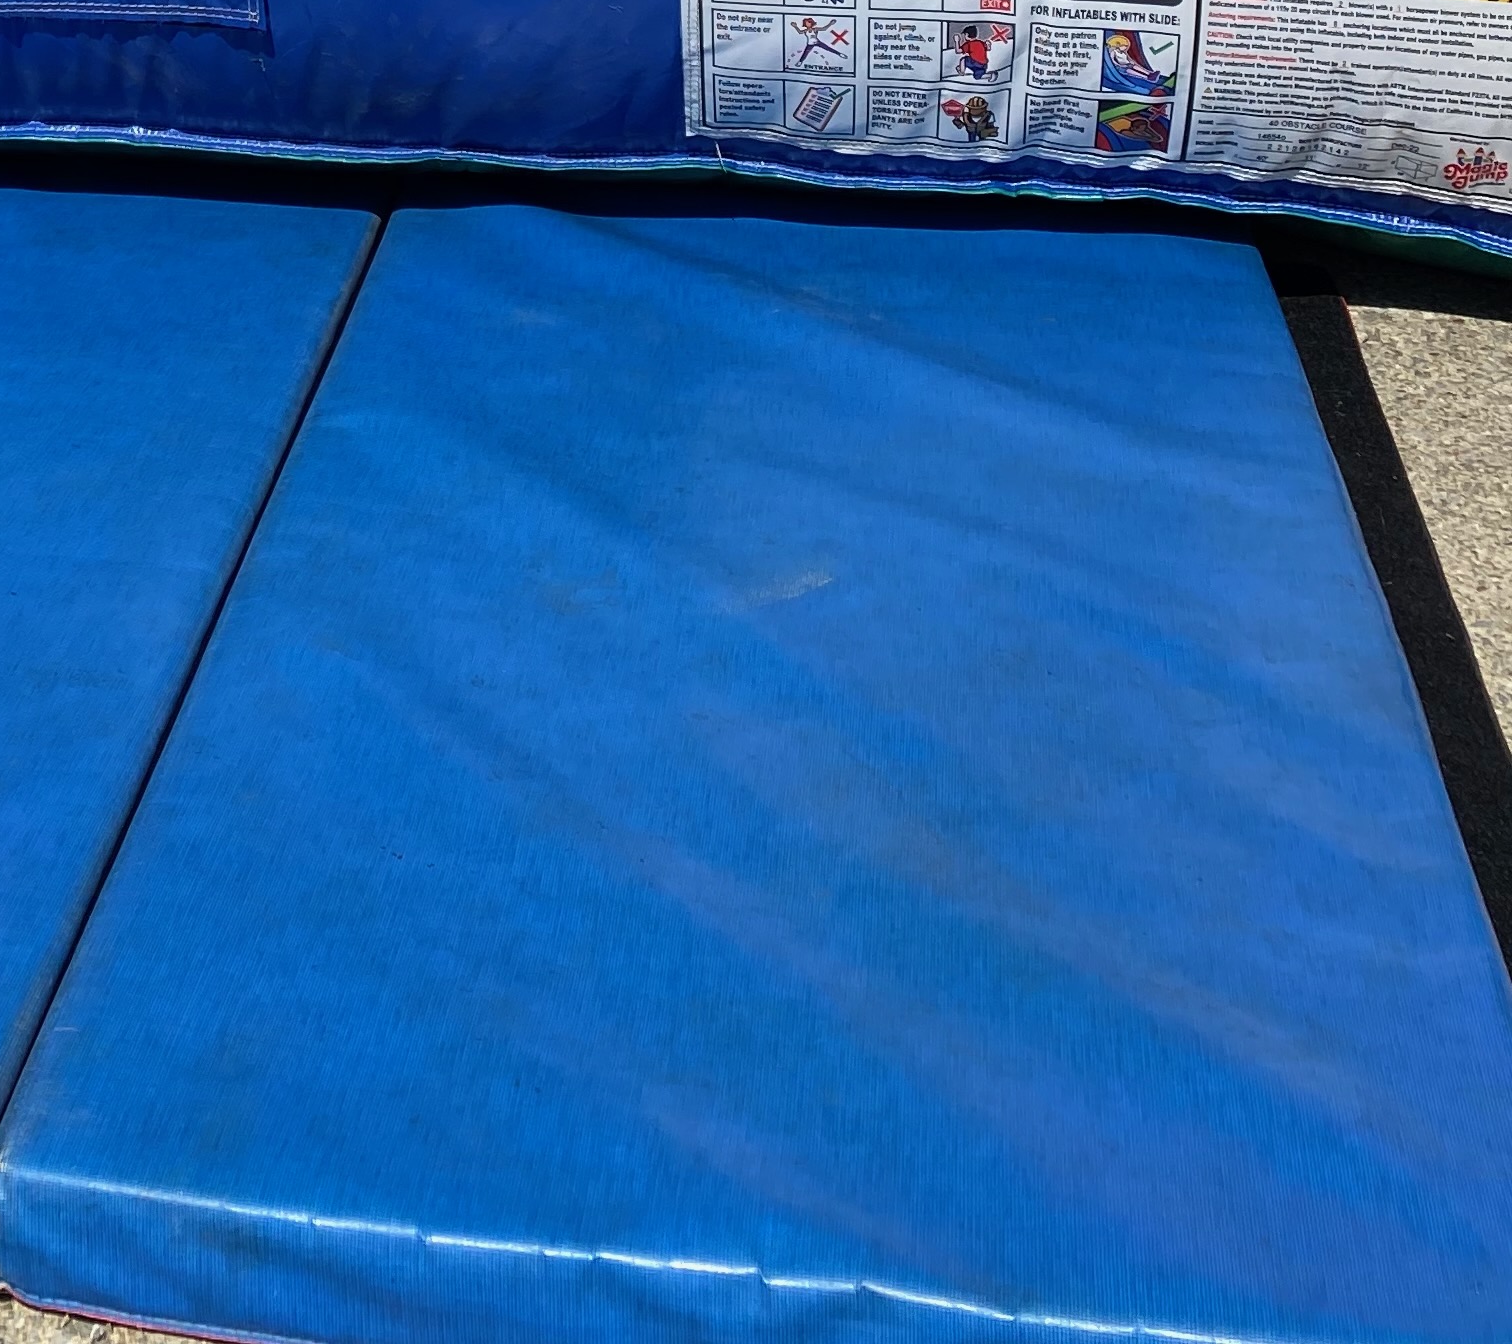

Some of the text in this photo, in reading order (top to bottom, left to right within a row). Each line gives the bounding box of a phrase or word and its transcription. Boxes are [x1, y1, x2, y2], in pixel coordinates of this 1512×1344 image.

[981, 0, 1002, 9] EXIT
[717, 13, 726, 21] Do
[741, 14, 756, 24] play
[1030, 6, 1049, 16] FOR
[1052, 7, 1117, 21] INFLATABLES
[1120, 12, 1145, 23] WITH
[730, 23, 761, 32] entrance
[1035, 27, 1052, 38] Only
[1071, 30, 1096, 41] patron
[1035, 37, 1060, 48] sliding
[1062, 39, 1070, 47] at
[1034, 46, 1052, 55] Slide
[1055, 48, 1070, 56] feet
[1034, 56, 1056, 65] hands
[1070, 61, 1087, 70] your
[1033, 65, 1078, 76] lap and feet
[1281, 121, 1327, 129] OBSTACLE
[1330, 122, 1366, 135] COURSE
[1444, 162, 1508, 177] Magic
[1452, 170, 1508, 189] Jump
